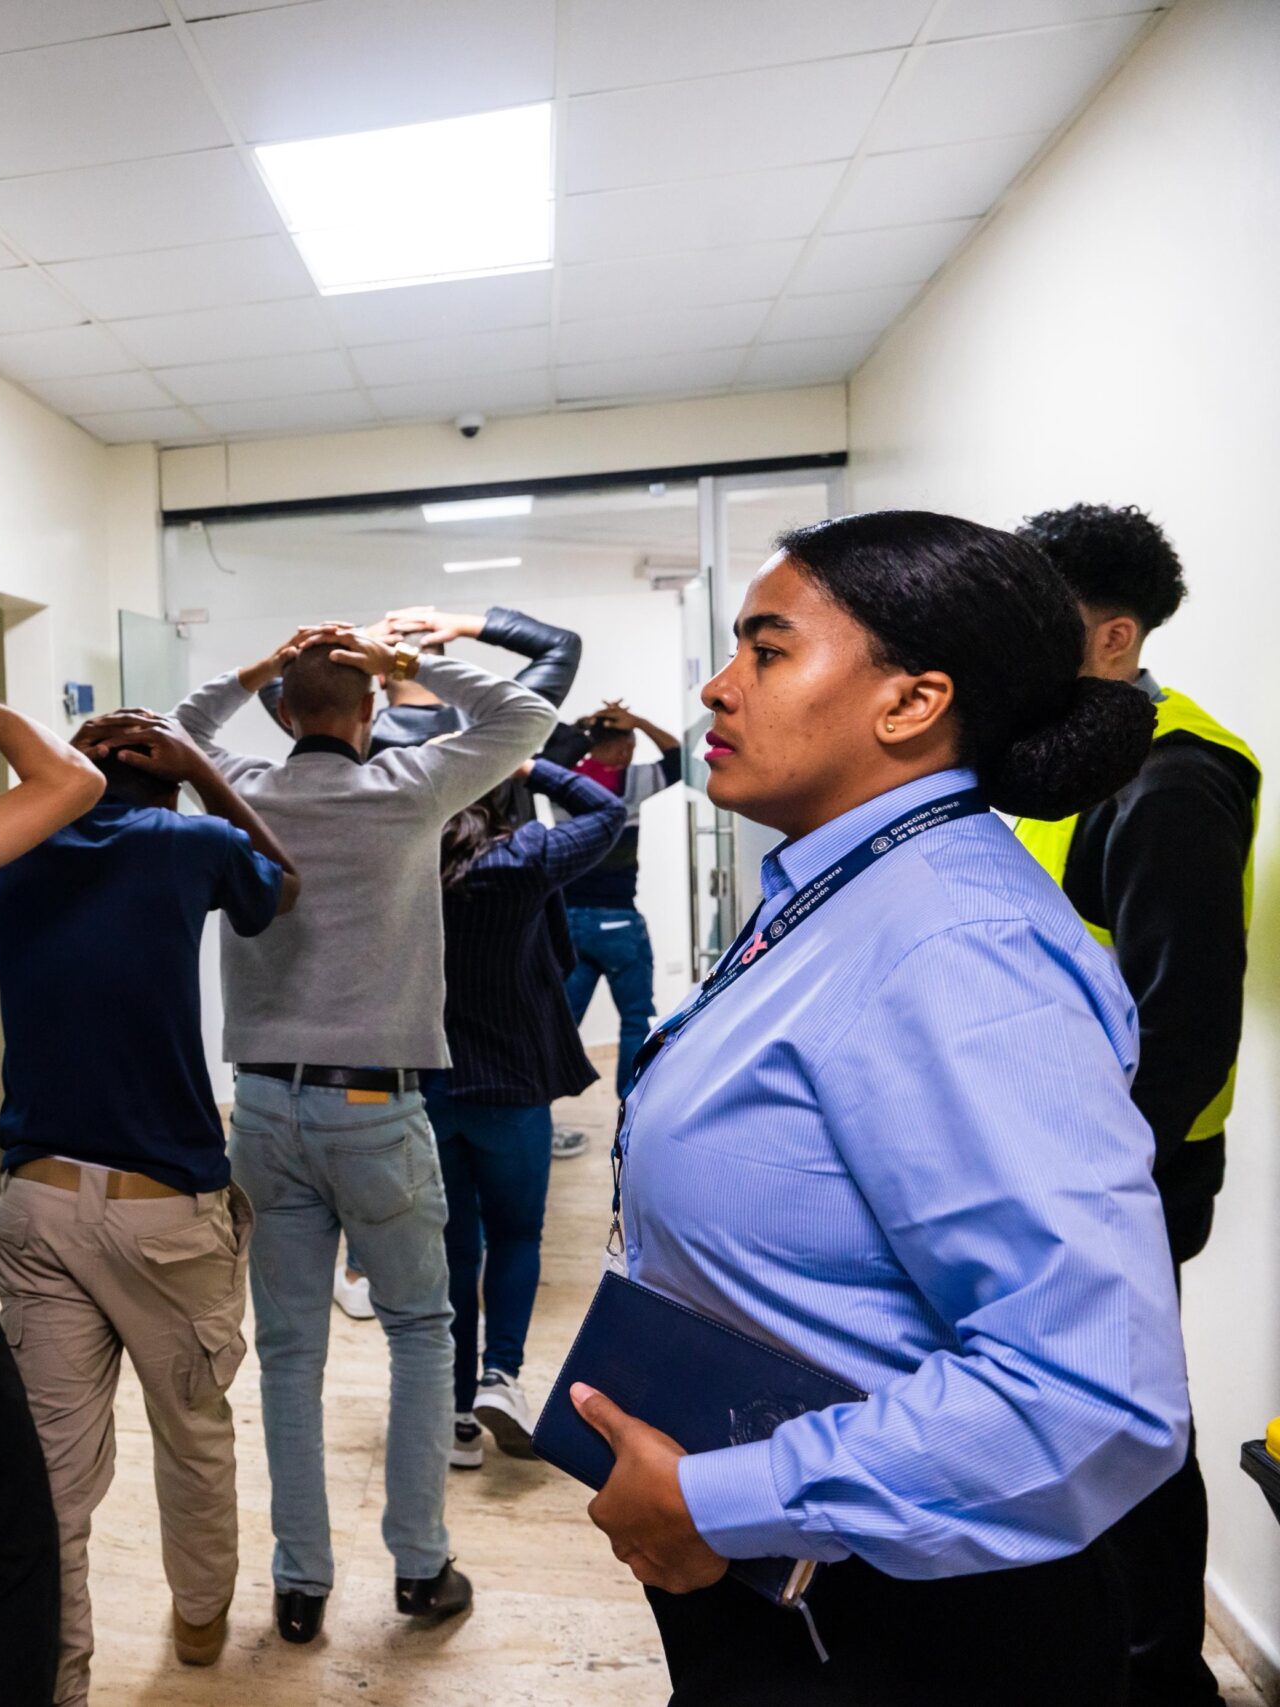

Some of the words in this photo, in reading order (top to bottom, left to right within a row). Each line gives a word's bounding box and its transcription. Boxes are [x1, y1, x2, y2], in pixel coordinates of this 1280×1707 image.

[890, 811, 931, 836] Dirección
[931, 801, 960, 814] General
[896, 833, 907, 842] de
[907, 814, 949, 835] Migración
[813, 866, 843, 890] General
[788, 915, 797, 924] de
[796, 886, 830, 916] Migración
